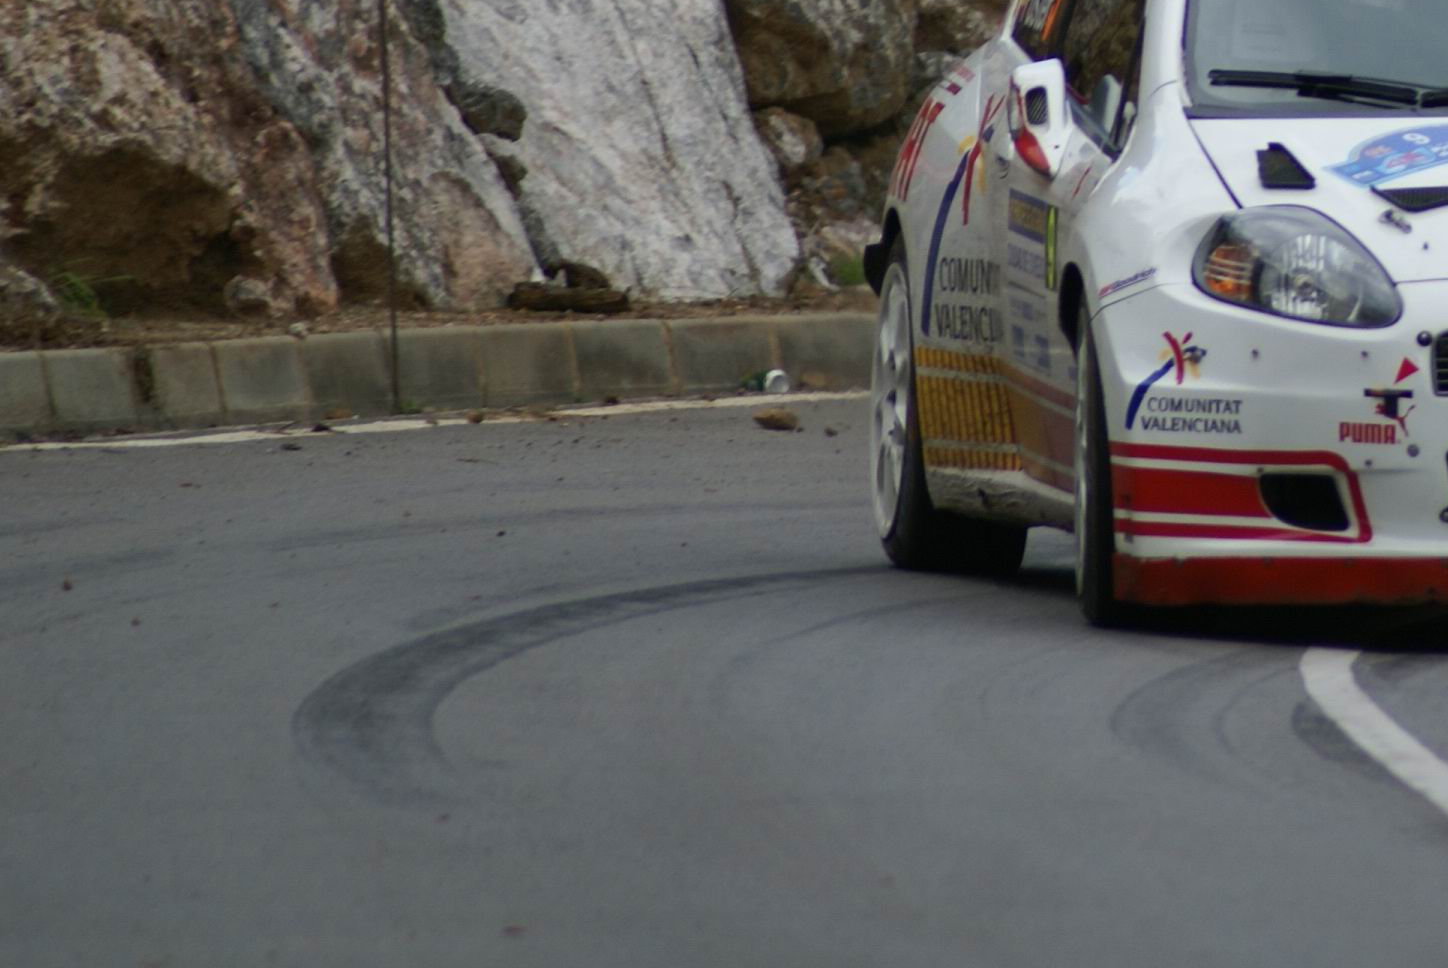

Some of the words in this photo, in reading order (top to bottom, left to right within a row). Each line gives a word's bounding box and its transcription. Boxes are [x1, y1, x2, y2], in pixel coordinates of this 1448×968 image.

[1147, 396, 1243, 415] COMUNITAT
[1140, 416, 1243, 434] VALENCIANA
[1338, 422, 1397, 444] PUMA
